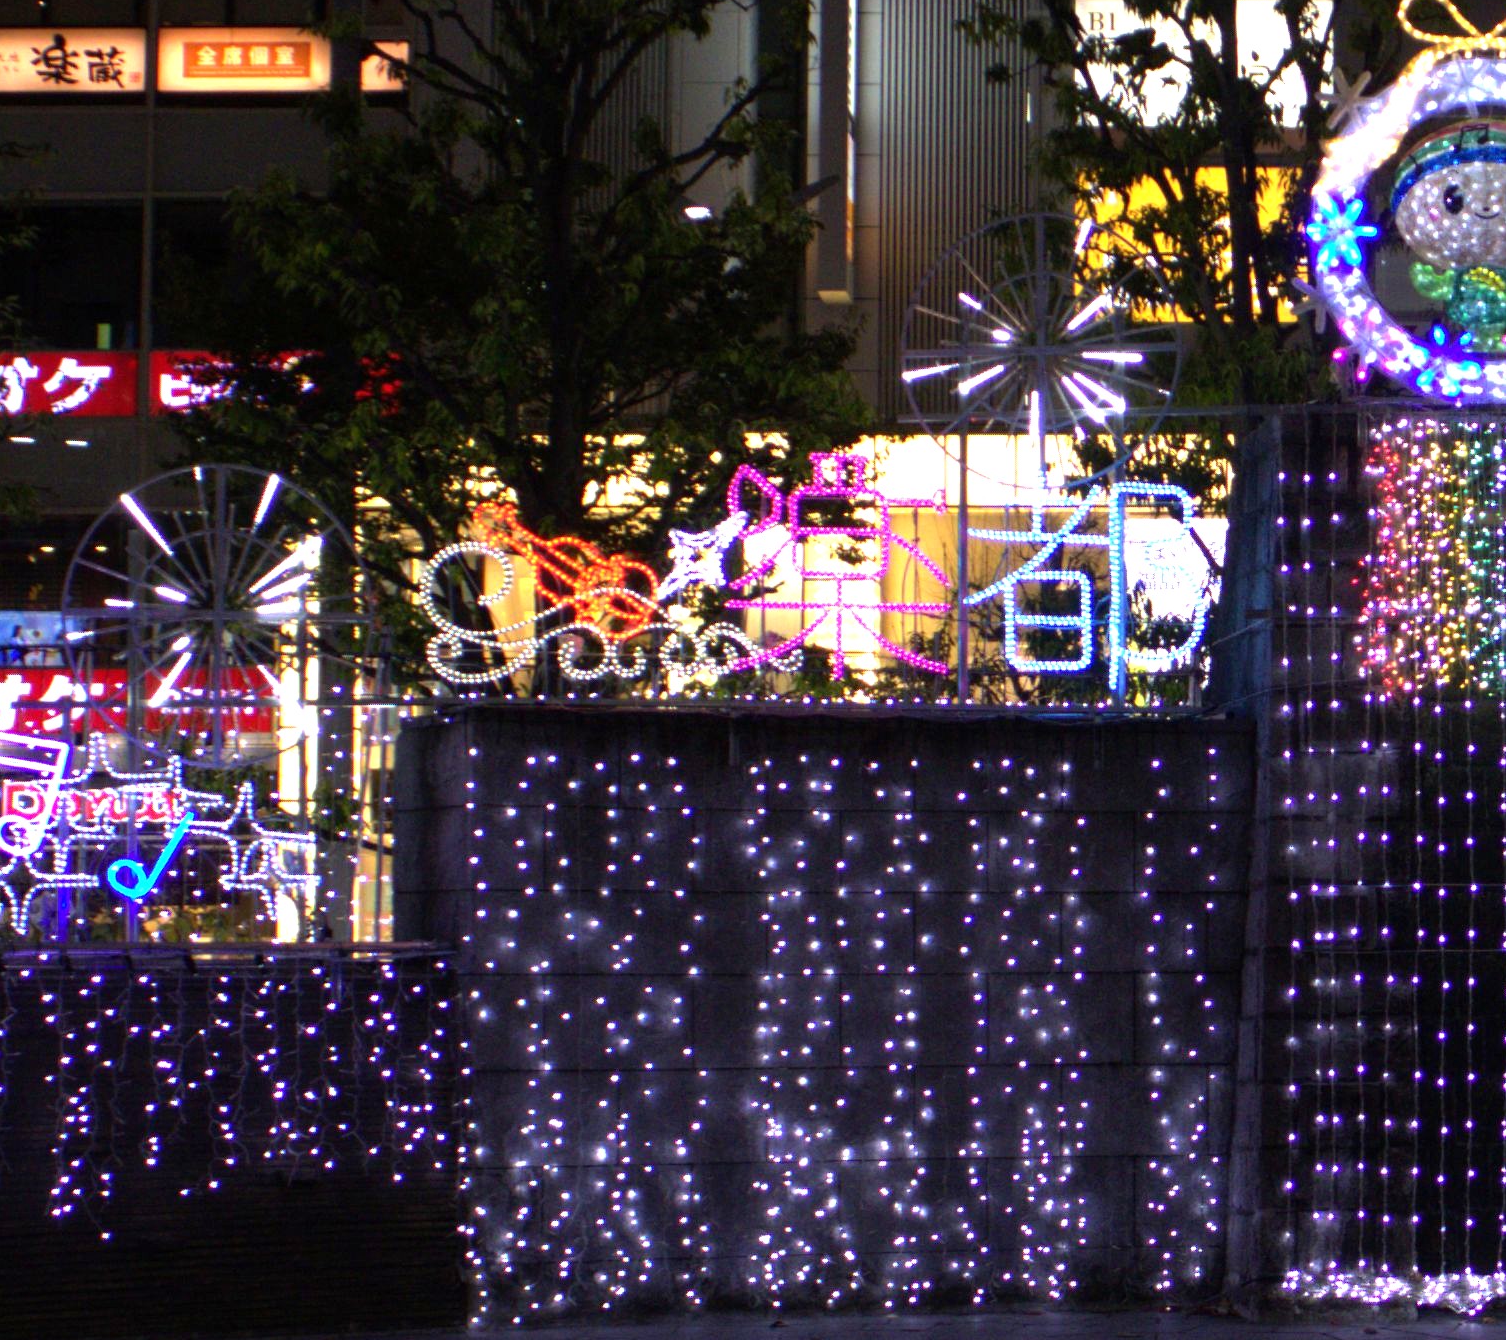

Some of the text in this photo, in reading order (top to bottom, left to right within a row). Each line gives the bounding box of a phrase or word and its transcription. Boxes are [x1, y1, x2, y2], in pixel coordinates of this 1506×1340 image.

[1088, 11, 1116, 31] B1
[30, 33, 127, 89] 楽蔵
[197, 45, 295, 66] 全席個室
